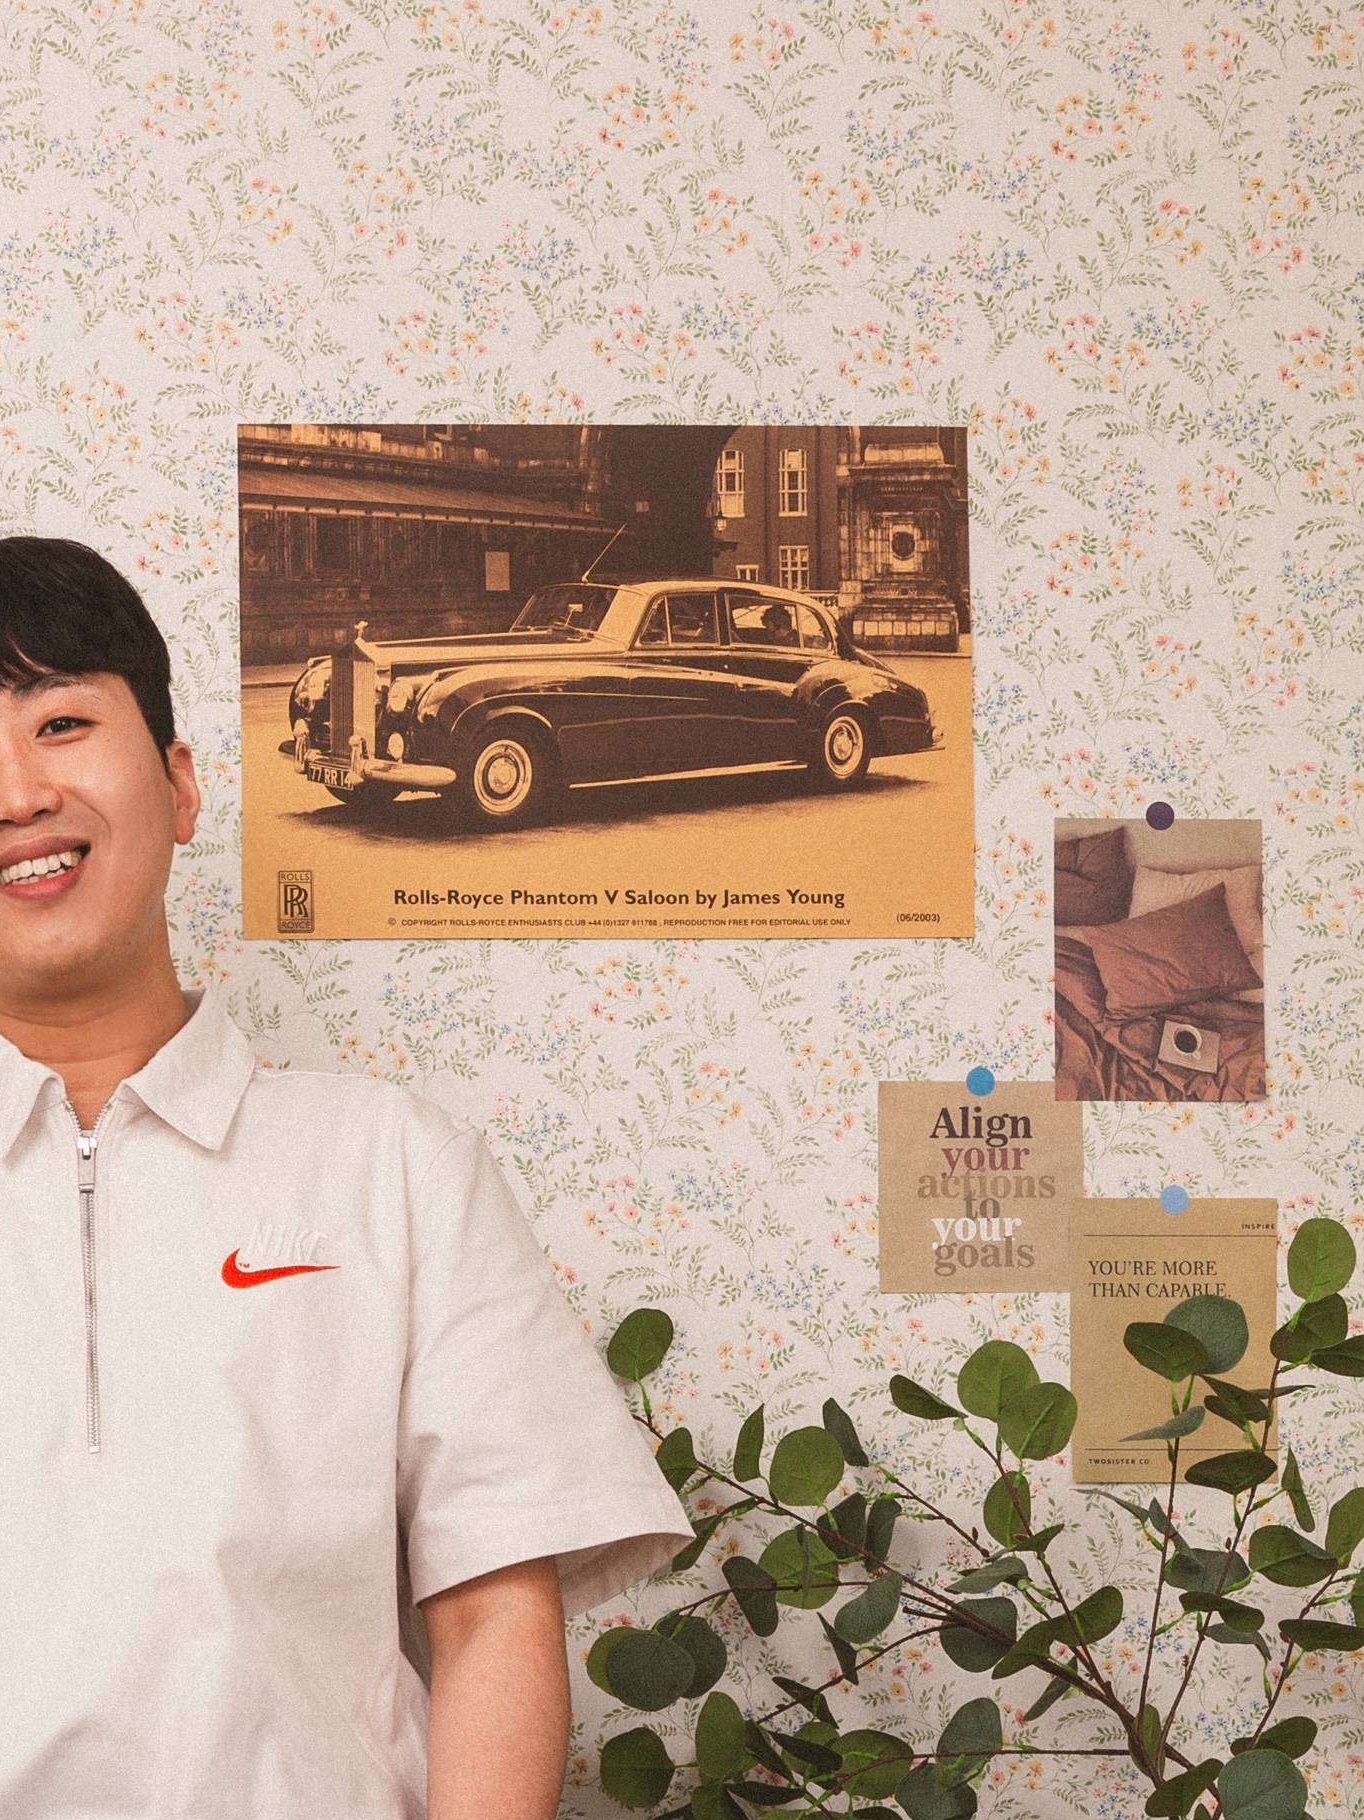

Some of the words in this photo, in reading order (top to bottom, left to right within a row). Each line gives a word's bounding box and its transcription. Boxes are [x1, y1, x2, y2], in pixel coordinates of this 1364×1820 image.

[310, 765, 322, 782] 77
[324, 768, 338, 785] RR
[280, 873, 310, 881] ROLLS
[393, 889, 504, 909] Rolls-Royce
[510, 889, 598, 905] Phantom
[604, 889, 619, 905] V
[624, 889, 689, 905] Saloon
[696, 889, 717, 909] by
[722, 889, 780, 909] James
[786, 889, 845, 909] Young
[281, 921, 311, 929] ROYCE
[770, 918, 810, 926] EDITORIAL
[812, 918, 828, 926] USE
[830, 918, 851, 926] ONLY
[897, 913, 940, 923] (06/2003)
[930, 1106, 1032, 1147] Align
[941, 1147, 1030, 1179] your
[917, 1168, 1056, 1199] actions
[964, 1189, 1000, 1221] to
[931, 1217, 1022, 1250] your
[934, 1236, 1035, 1277] goals
[1088, 1260, 1156, 1275] YOU'RE
[1162, 1261, 1217, 1275] MORE
[1089, 1283, 1140, 1297] THAN
